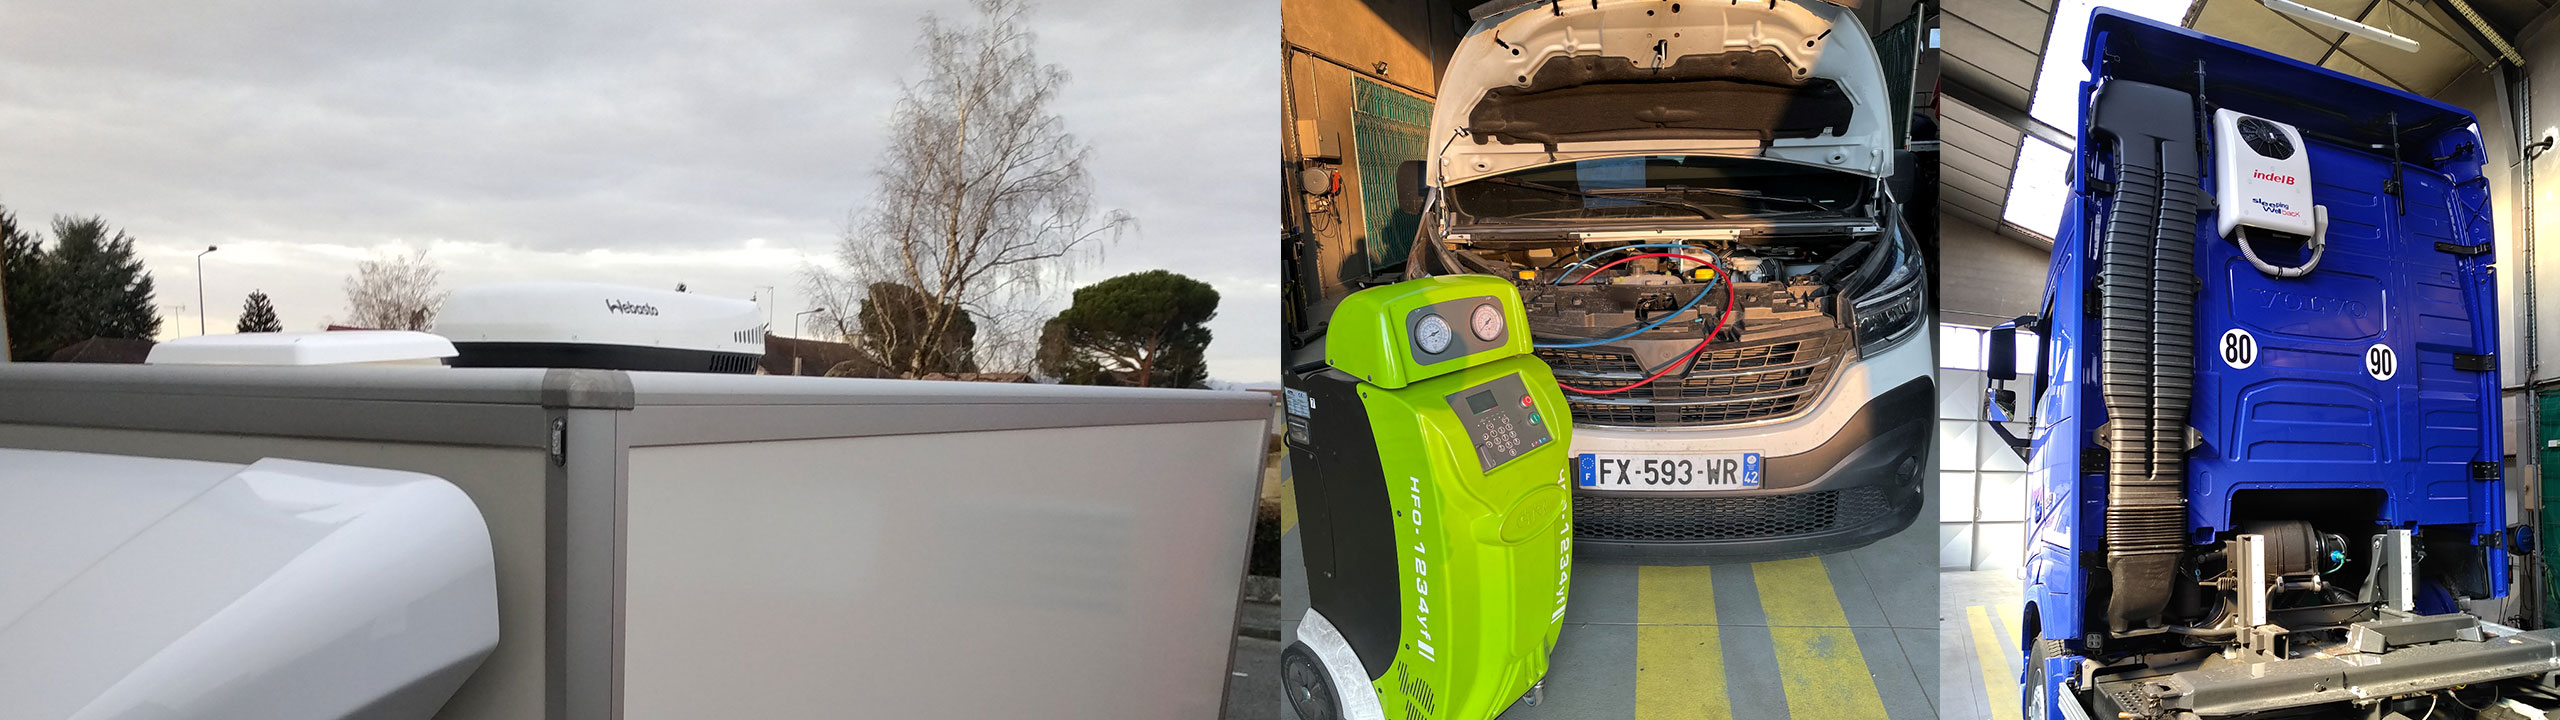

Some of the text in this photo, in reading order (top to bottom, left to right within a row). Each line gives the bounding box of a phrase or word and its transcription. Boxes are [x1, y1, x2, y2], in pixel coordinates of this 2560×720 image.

[605, 299, 659, 316] Webasto
[2250, 288, 2368, 319] VOLVO
[2226, 333, 2251, 364] 80
[2371, 348, 2392, 376] 90
[1600, 459, 1738, 485] FX-593-WR
[1744, 471, 1758, 484] 42
[1409, 476, 1431, 641] HFO-1234yf
